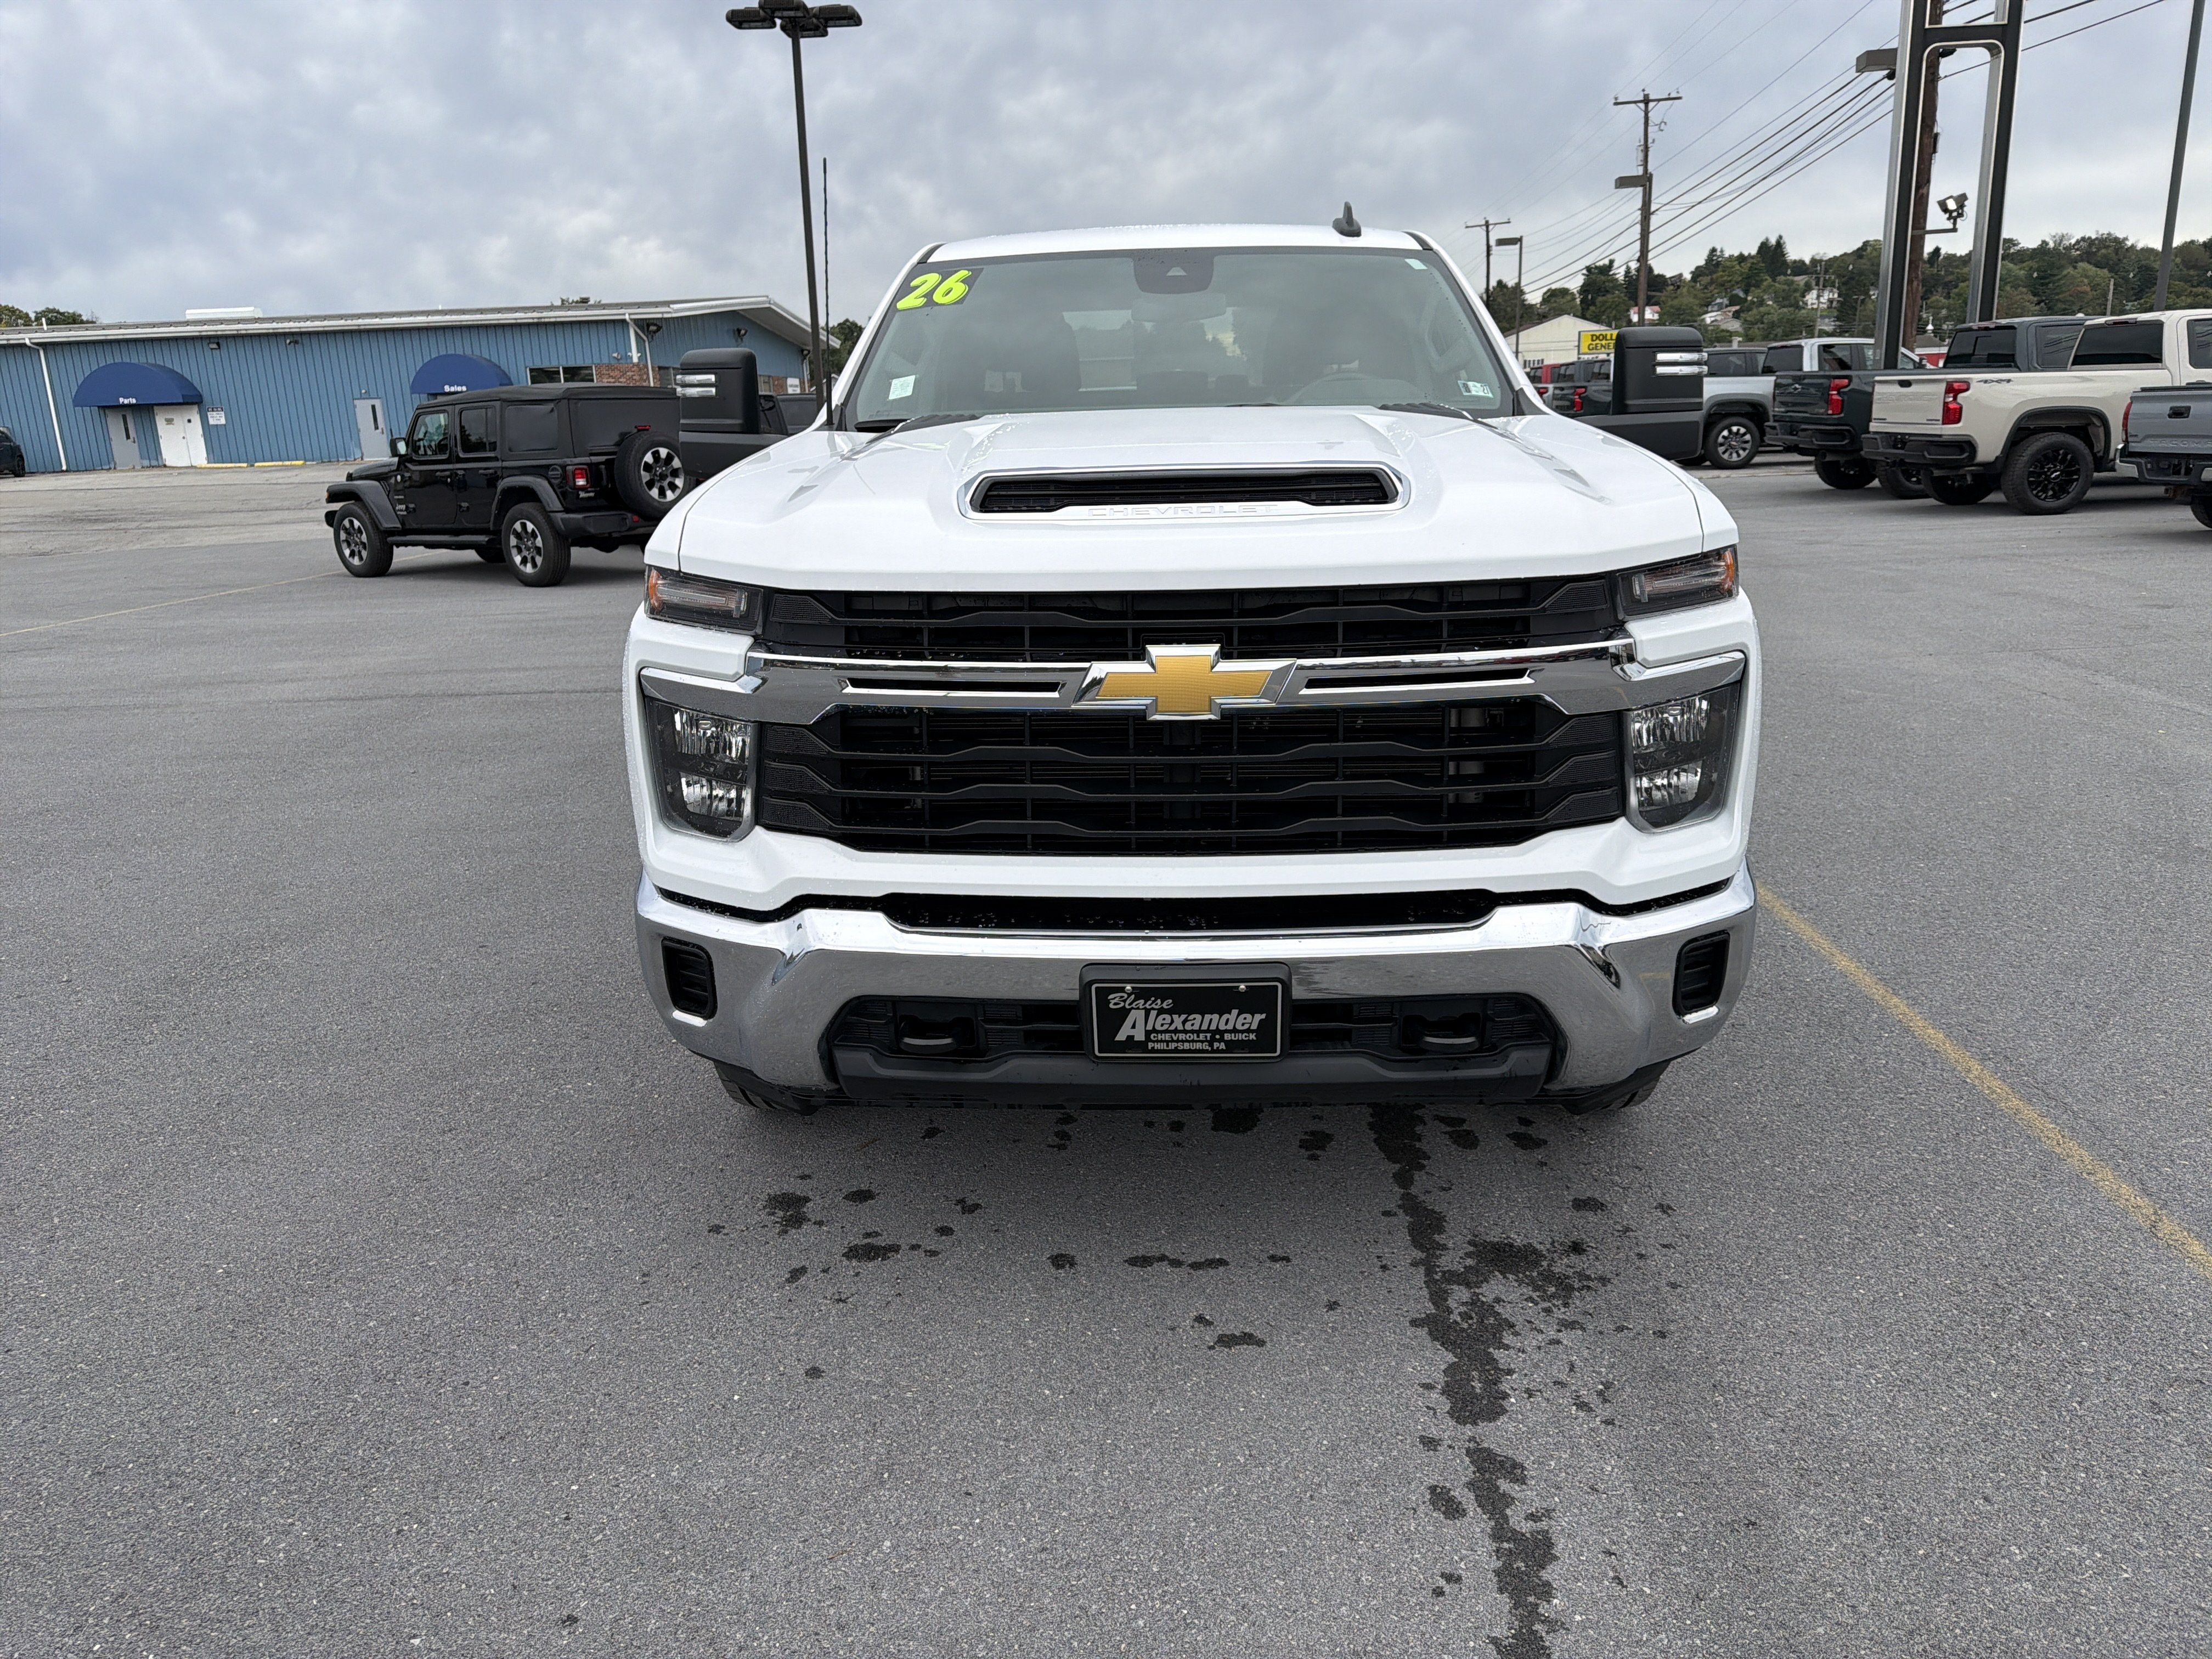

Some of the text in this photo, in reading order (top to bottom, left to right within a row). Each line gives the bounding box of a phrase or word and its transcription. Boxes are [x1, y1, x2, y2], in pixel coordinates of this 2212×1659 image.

[896, 270, 972, 310] 26
[1590, 332, 1616, 342] DOLL
[1088, 504, 1278, 516] CHEVROLET
[1108, 992, 1174, 1009] Blaise
[1114, 1009, 1267, 1041] Alexander
[1148, 1042, 1211, 1051] PHILIPSBURG,
